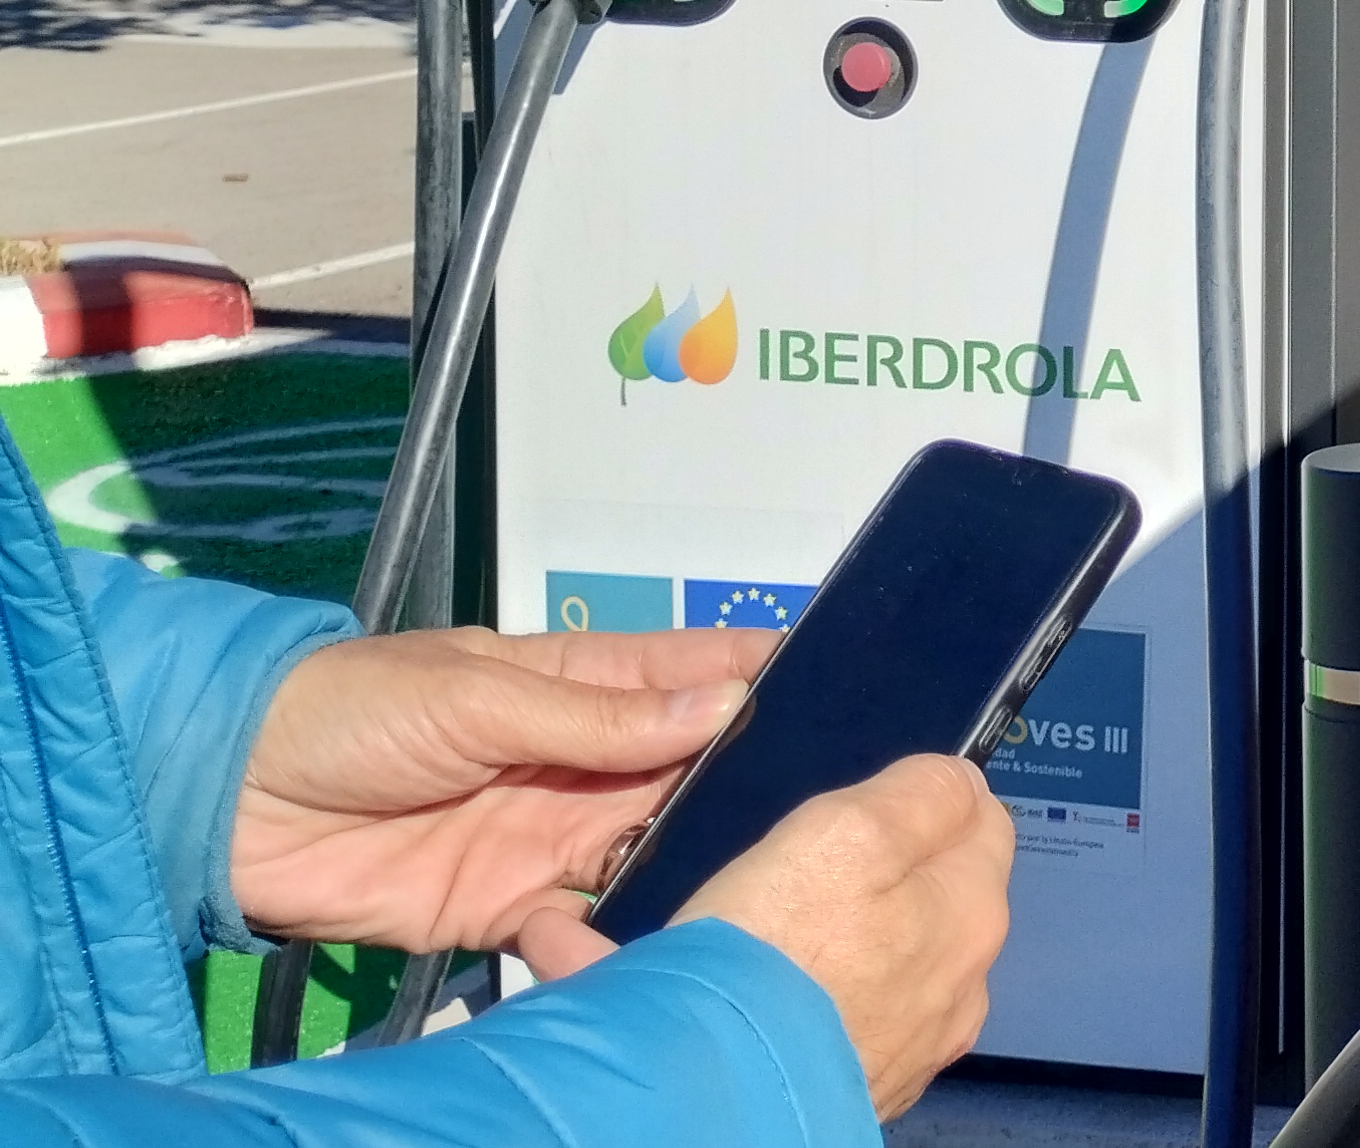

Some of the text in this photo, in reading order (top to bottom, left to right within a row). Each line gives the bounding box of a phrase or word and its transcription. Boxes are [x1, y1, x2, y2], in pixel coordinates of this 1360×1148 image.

[759, 327, 1142, 402] IBERDROLA
[1003, 715, 1096, 751] oves
[1013, 760, 1021, 773] &
[1024, 761, 1083, 779] Sostenible
